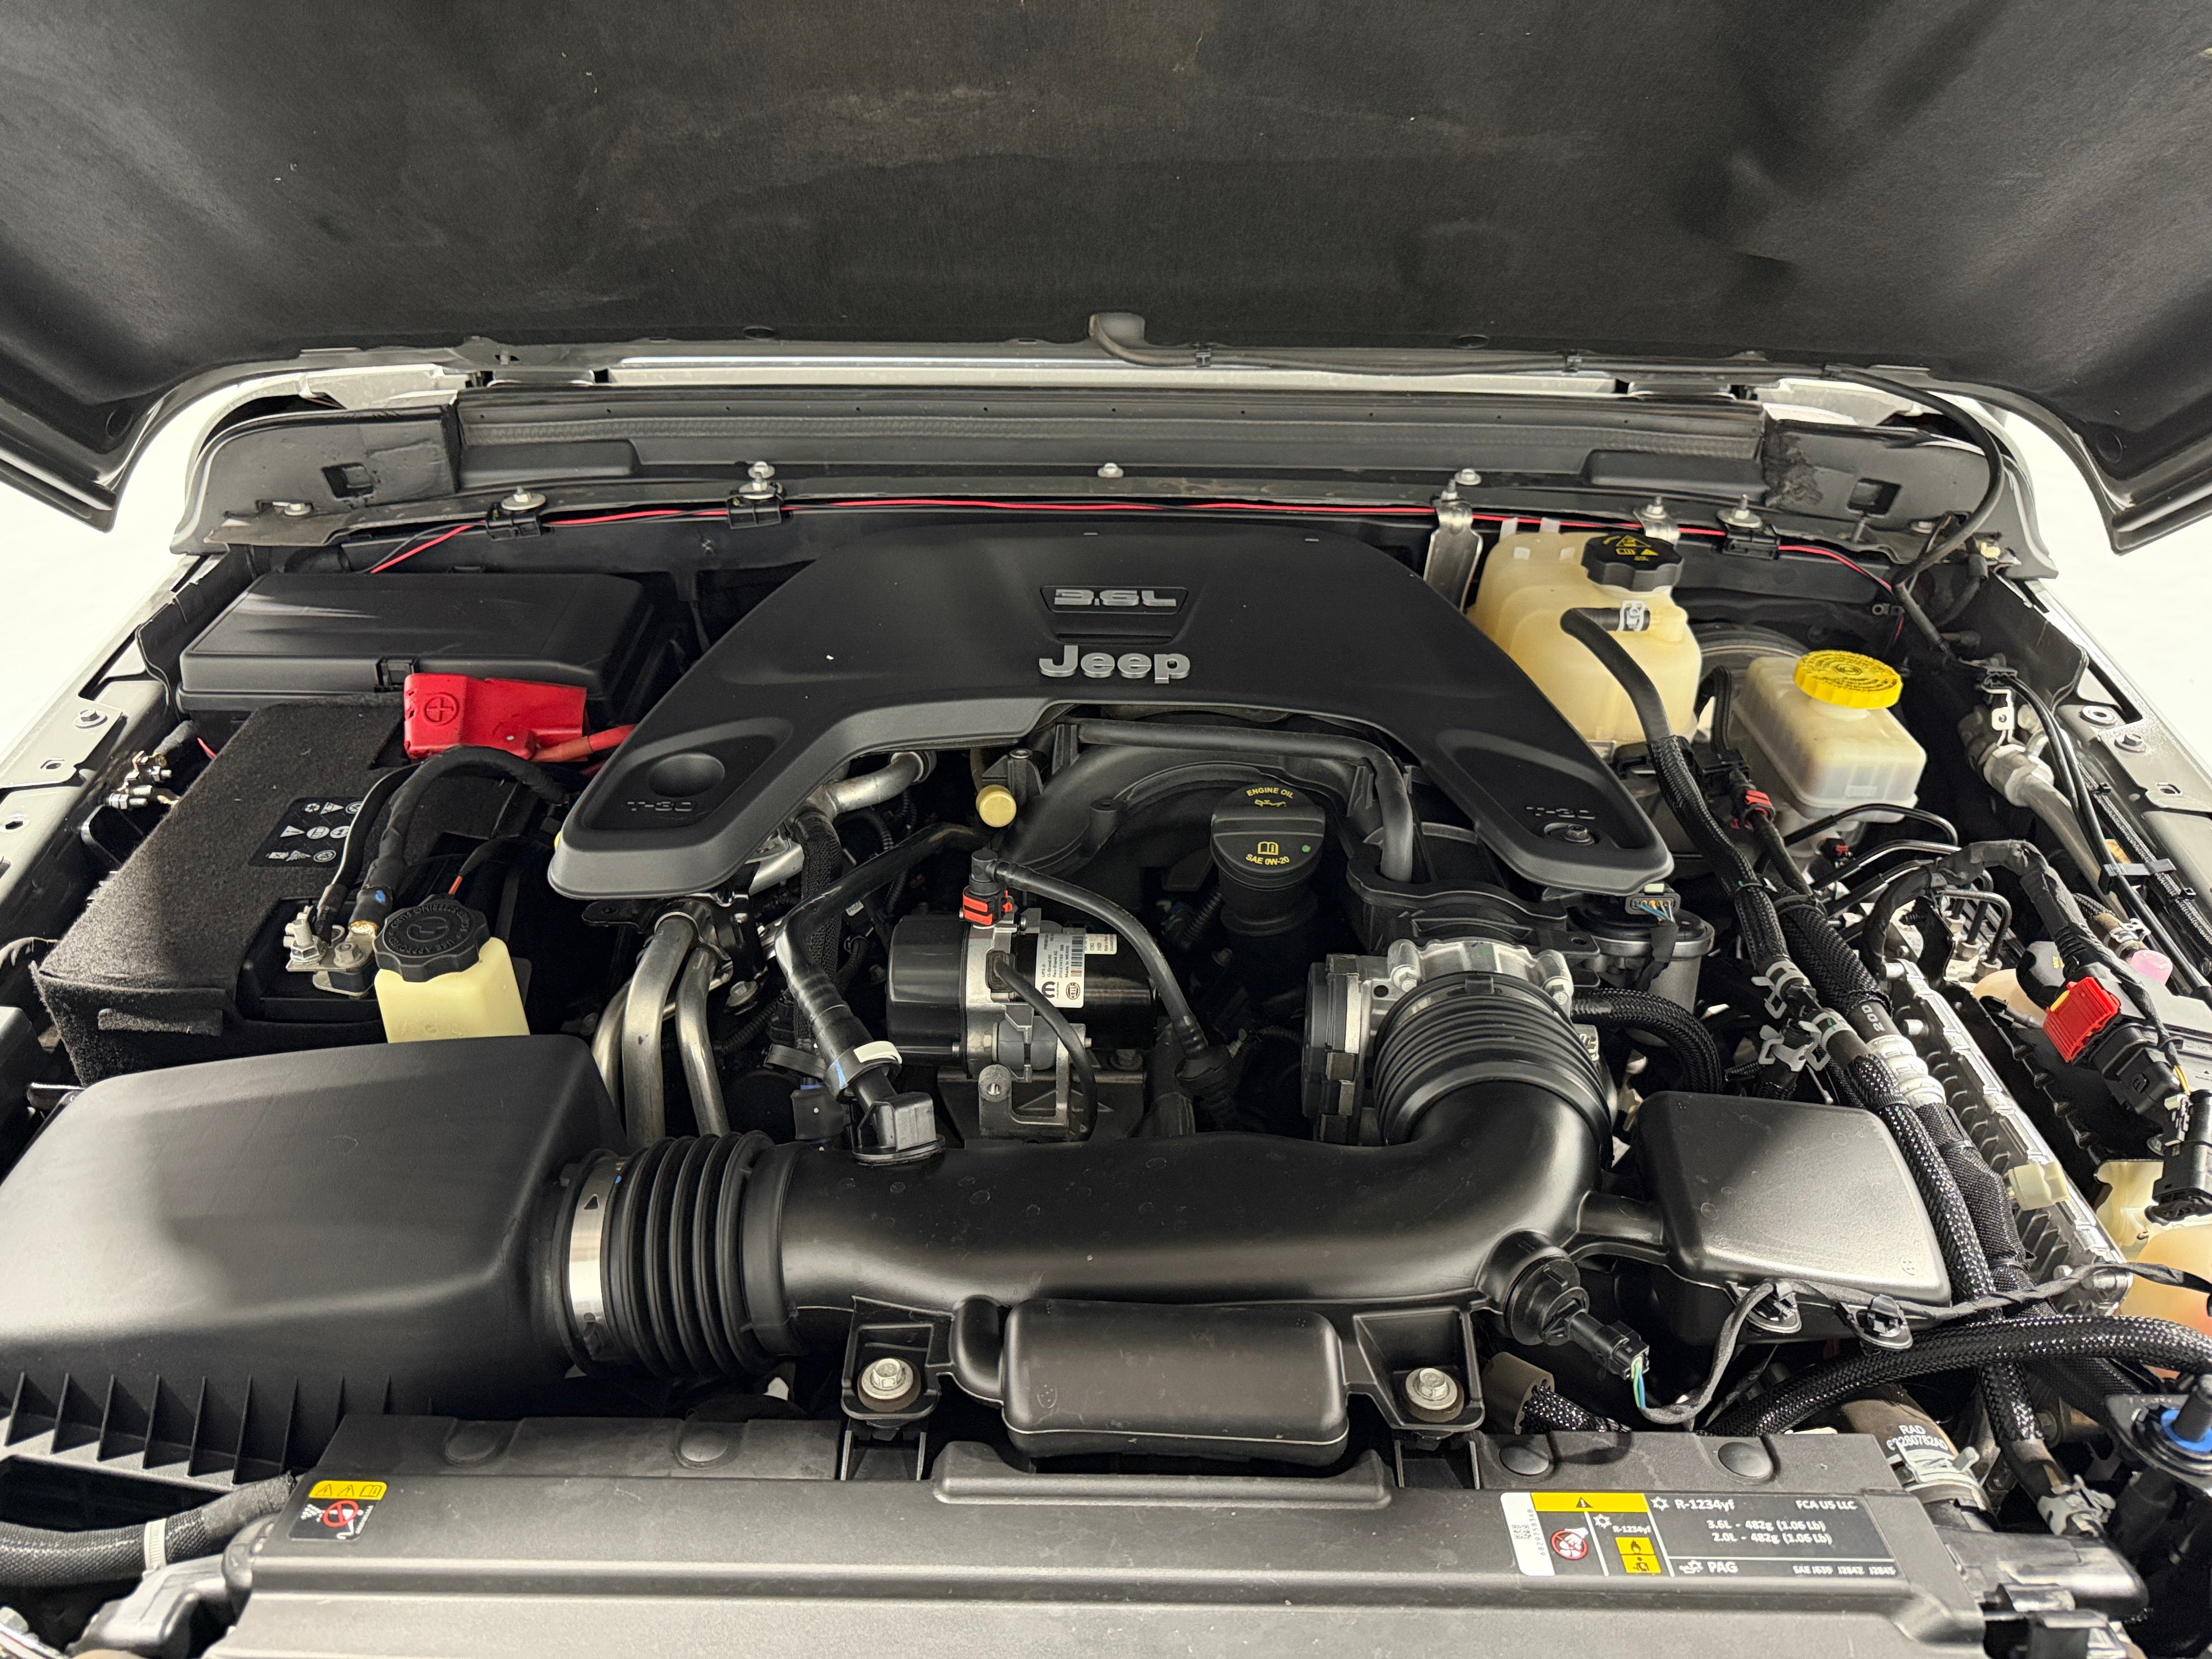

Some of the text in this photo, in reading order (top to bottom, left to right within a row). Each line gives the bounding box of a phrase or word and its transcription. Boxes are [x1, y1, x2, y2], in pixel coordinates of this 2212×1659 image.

[1054, 589, 1177, 607] 3.6L
[1039, 645, 1190, 684] Jeep
[1246, 787, 1294, 799] ENGINE OIL
[1245, 854, 1290, 865] SAE 0W-20
[1898, 1425, 1926, 1435] RAD
[1674, 1499, 1735, 1511] R-1234yf
[1796, 1500, 1858, 1510] FCA US LLC
[1612, 1525, 1652, 1534] R-1234yf
[1706, 1520, 1733, 1530] 3.6L
[1745, 1520, 1775, 1532] 482g
[1776, 1520, 1806, 1532] (1.06
[1711, 1532, 1738, 1542] 2.0L
[1751, 1533, 1781, 1544] 482g
[1782, 1532, 1813, 1545] (1.06
[1707, 1561, 1739, 1573] PAG
[1792, 1565, 1812, 1575] SAE
